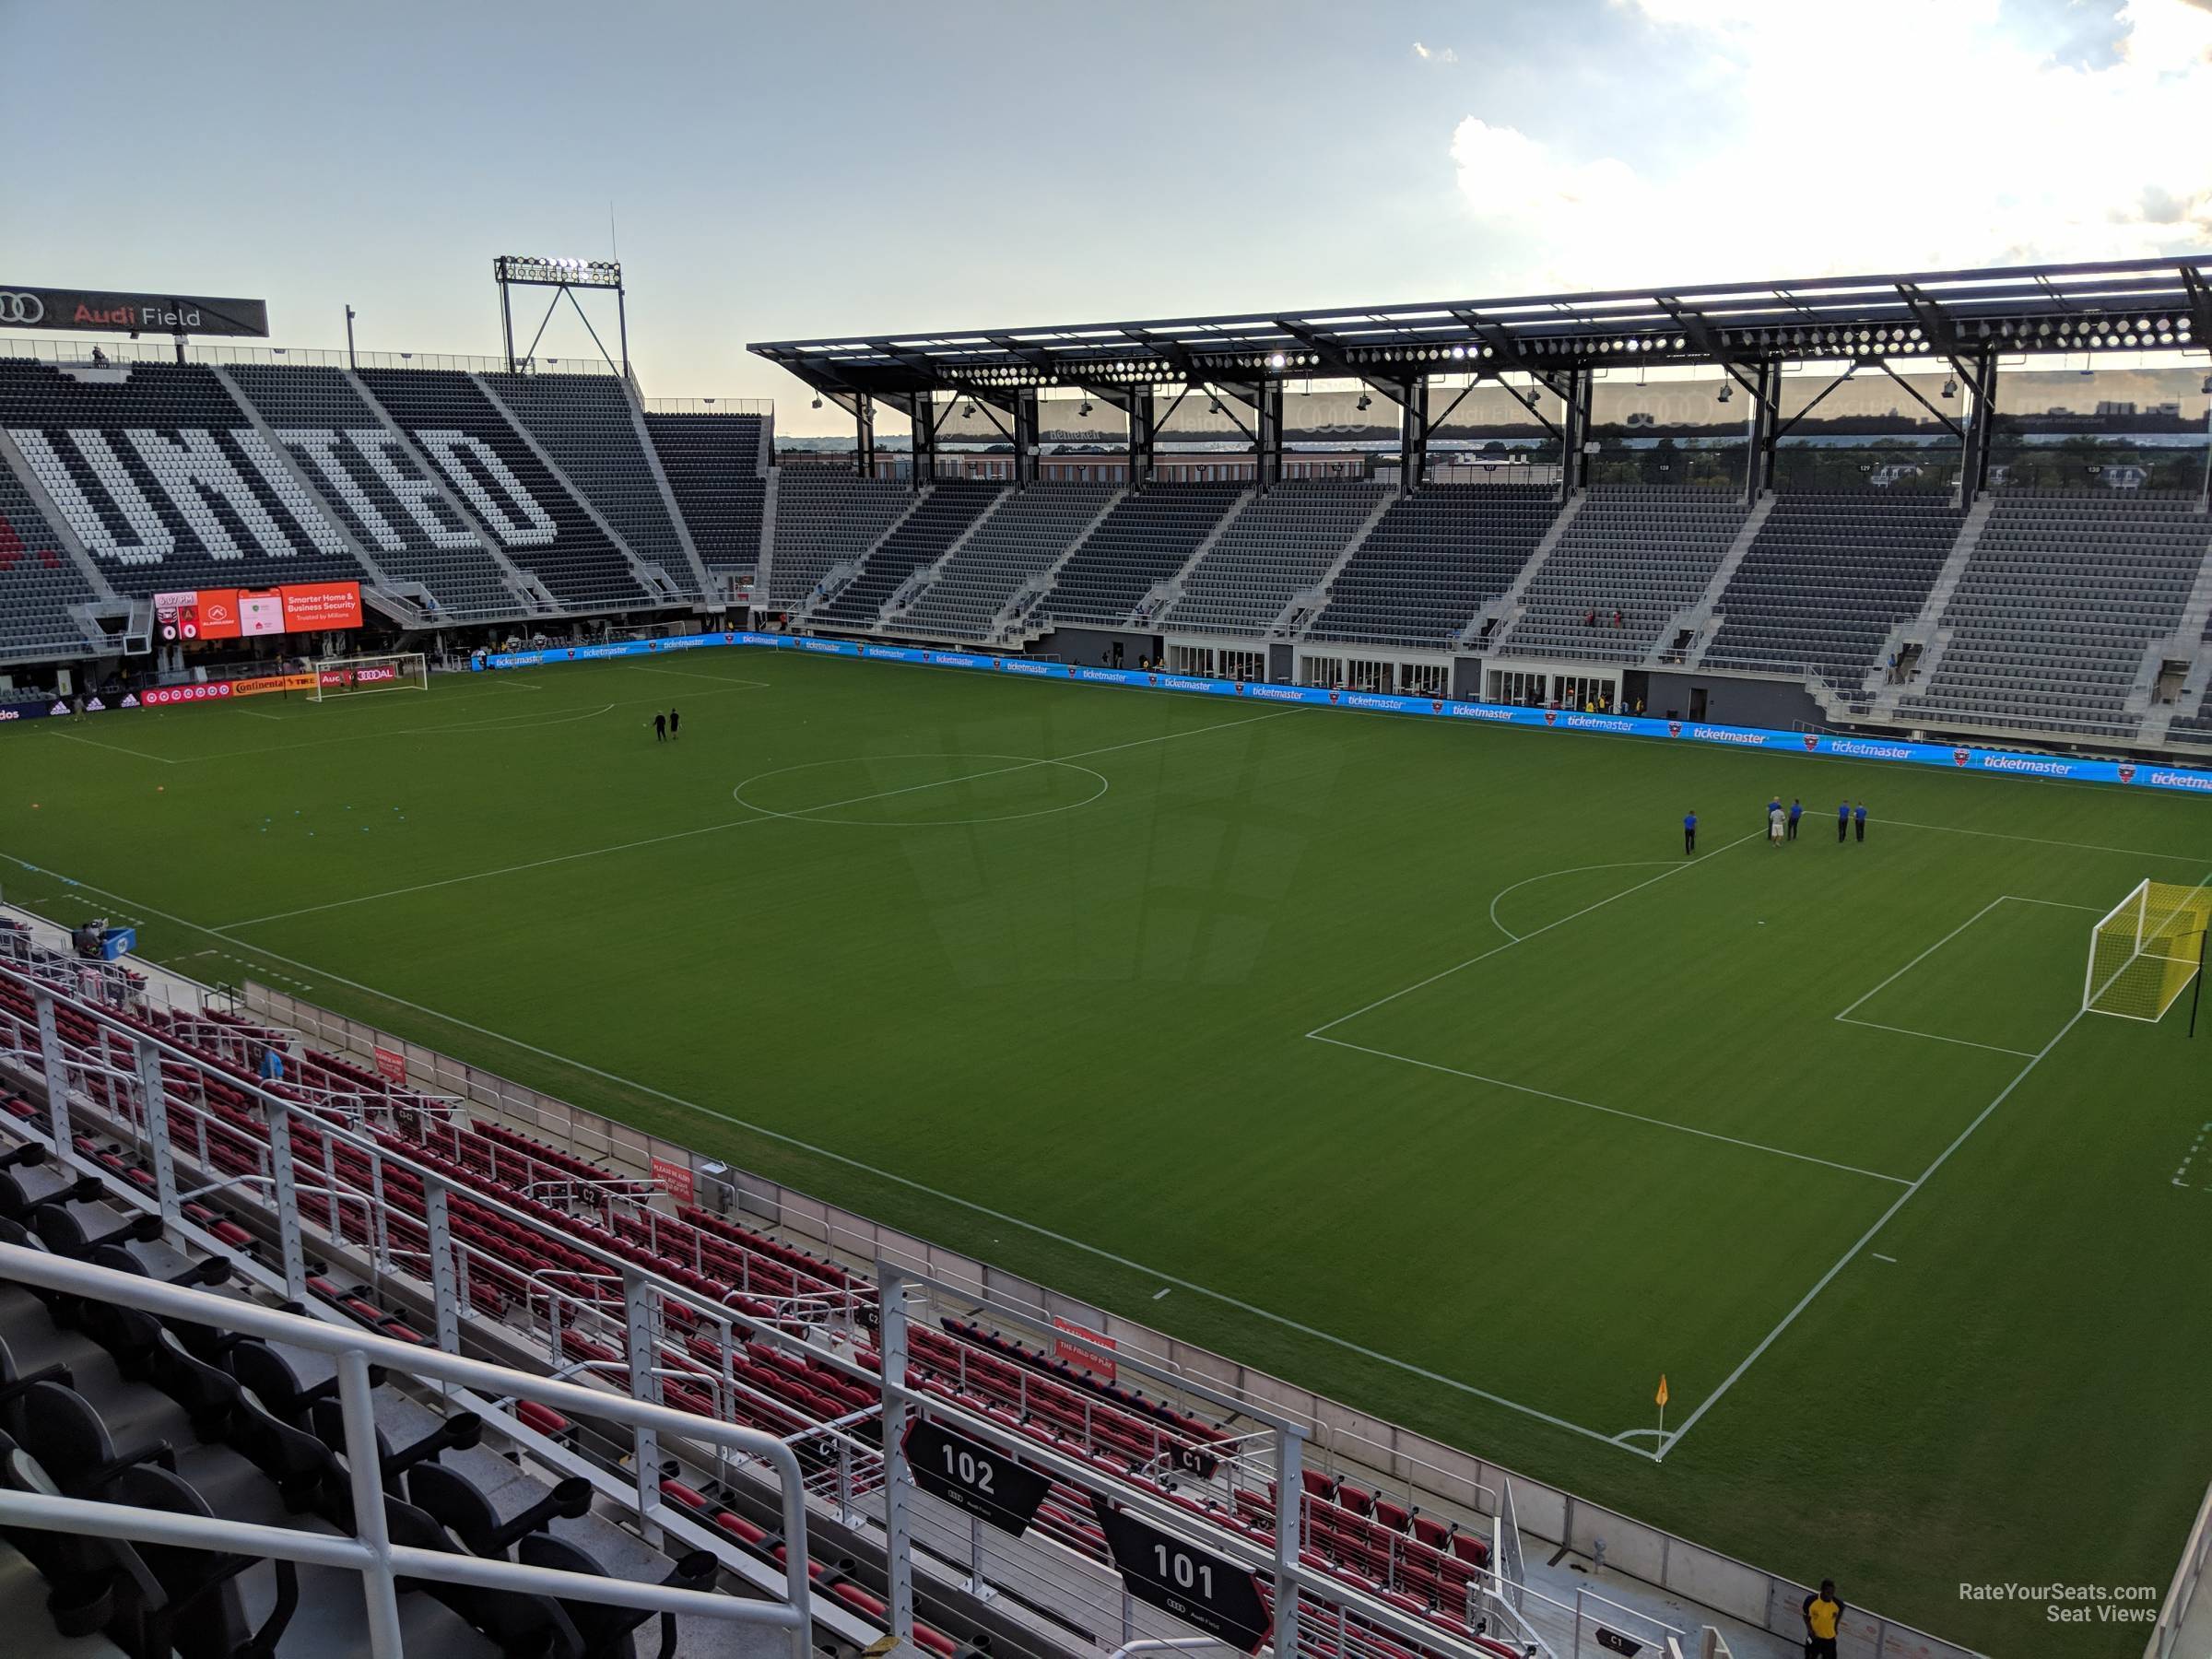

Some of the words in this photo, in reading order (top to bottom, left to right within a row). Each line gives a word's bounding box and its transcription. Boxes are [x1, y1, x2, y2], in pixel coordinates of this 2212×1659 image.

[74, 302, 135, 325] Audi
[142, 307, 201, 327] Field
[180, 594, 194, 604] PM
[288, 595, 320, 605] Smarter
[322, 593, 346, 601] Home
[288, 604, 322, 612] Business
[324, 601, 356, 609] Security
[163, 626, 176, 640] 0
[184, 624, 196, 638] 0
[664, 639, 704, 649] ticketmaster
[743, 635, 779, 645] ticketmaster
[806, 641, 840, 652] ticketmaster
[583, 647, 628, 657] ticketmaster
[869, 648, 905, 659] ticketmaster
[936, 655, 974, 666] ticketmaster
[1007, 662, 1047, 674] ticketmaster
[1083, 670, 1126, 682] ticketmaster
[236, 678, 285, 693] Continental
[1164, 677, 1210, 691] ticketmaster
[1253, 686, 1303, 700] ticketmaster
[1348, 695, 1402, 710] ticketmaster
[1453, 705, 1512, 720] ticketmaster
[1568, 715, 1633, 731] ticketmaster
[1693, 727, 1766, 744] ticketmaster
[1831, 740, 1911, 759] ticketmaster
[1983, 756, 2072, 775] ticketmaster
[583, 1189, 594, 1203] C2
[1061, 1341, 1073, 1351] THE
[1073, 1346, 1088, 1357] FIELD
[1182, 1451, 1201, 1472] C1
[942, 1443, 994, 1495] 102
[1154, 1543, 1212, 1600] 101
[1610, 1635, 1622, 1646] C1
